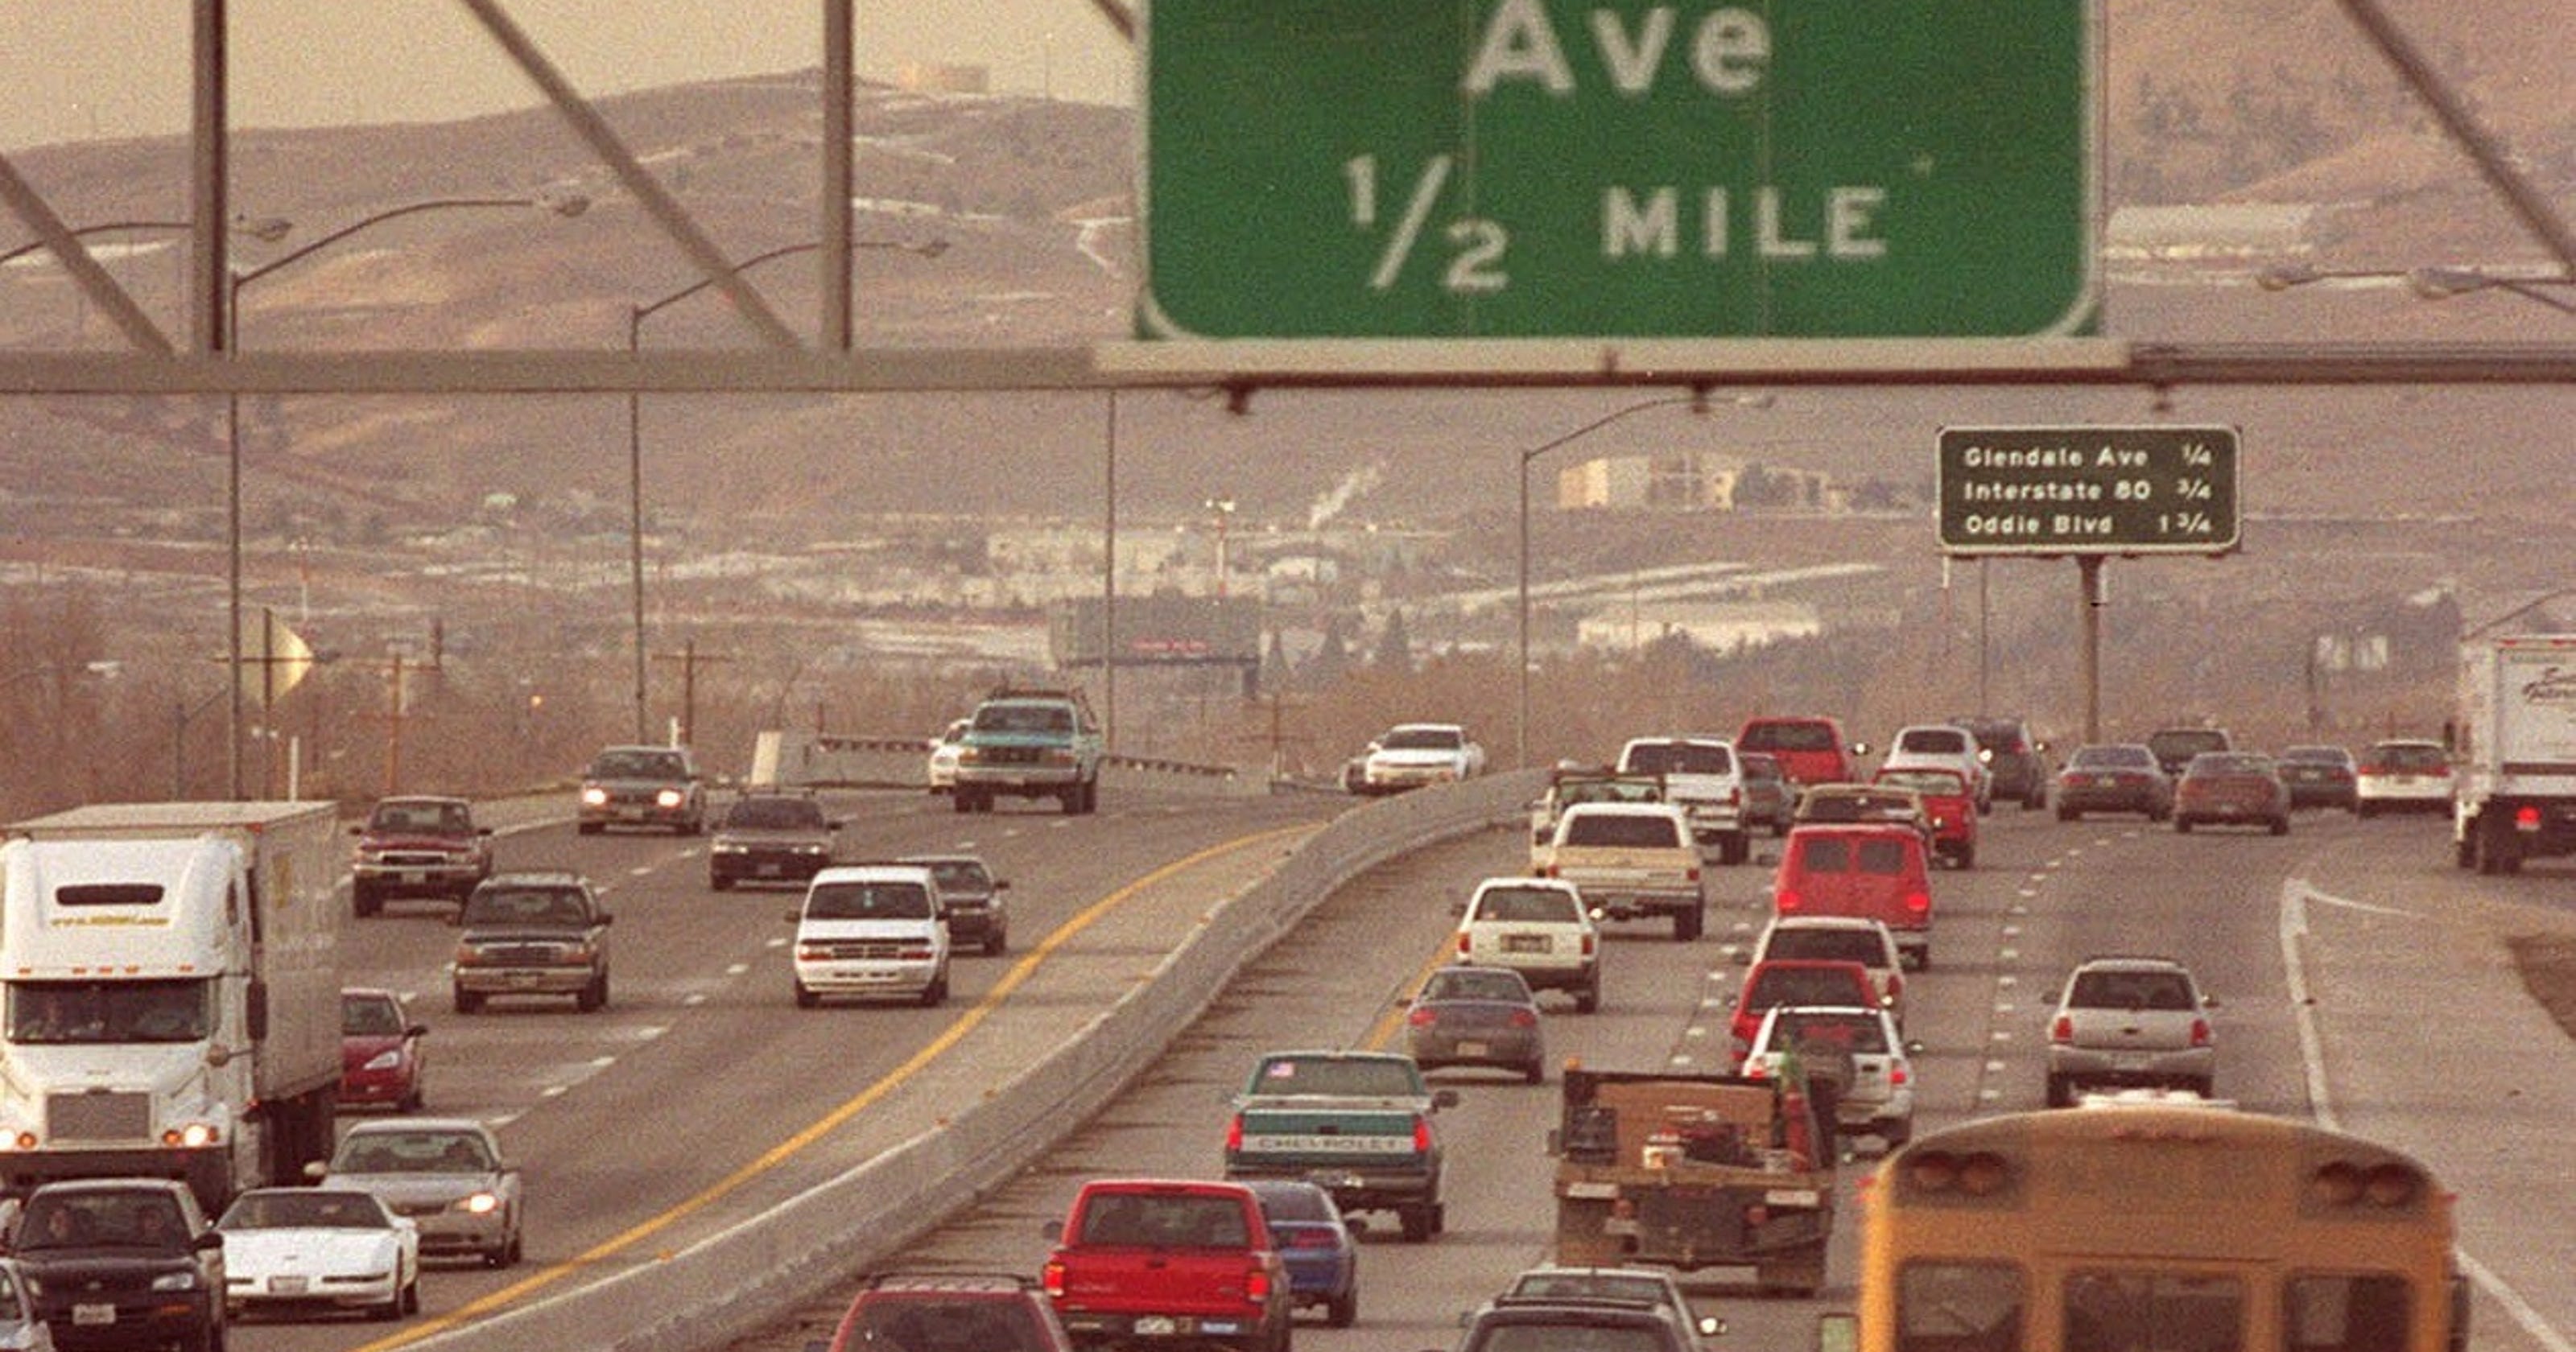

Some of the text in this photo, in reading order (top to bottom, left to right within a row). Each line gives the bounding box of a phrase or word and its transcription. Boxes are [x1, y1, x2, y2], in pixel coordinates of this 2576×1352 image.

[1463, 0, 1770, 94] Ave
[1600, 186, 1886, 259] MILE
[1964, 447, 2083, 467] Glendale
[2096, 446, 2149, 467] Ave
[1964, 481, 2102, 501] Interstate
[2114, 480, 2151, 500] 80
[1966, 514, 2040, 534] Oddie
[2054, 515, 2113, 534] Blvd
[1257, 1136, 1397, 1150] CHEVROLET
